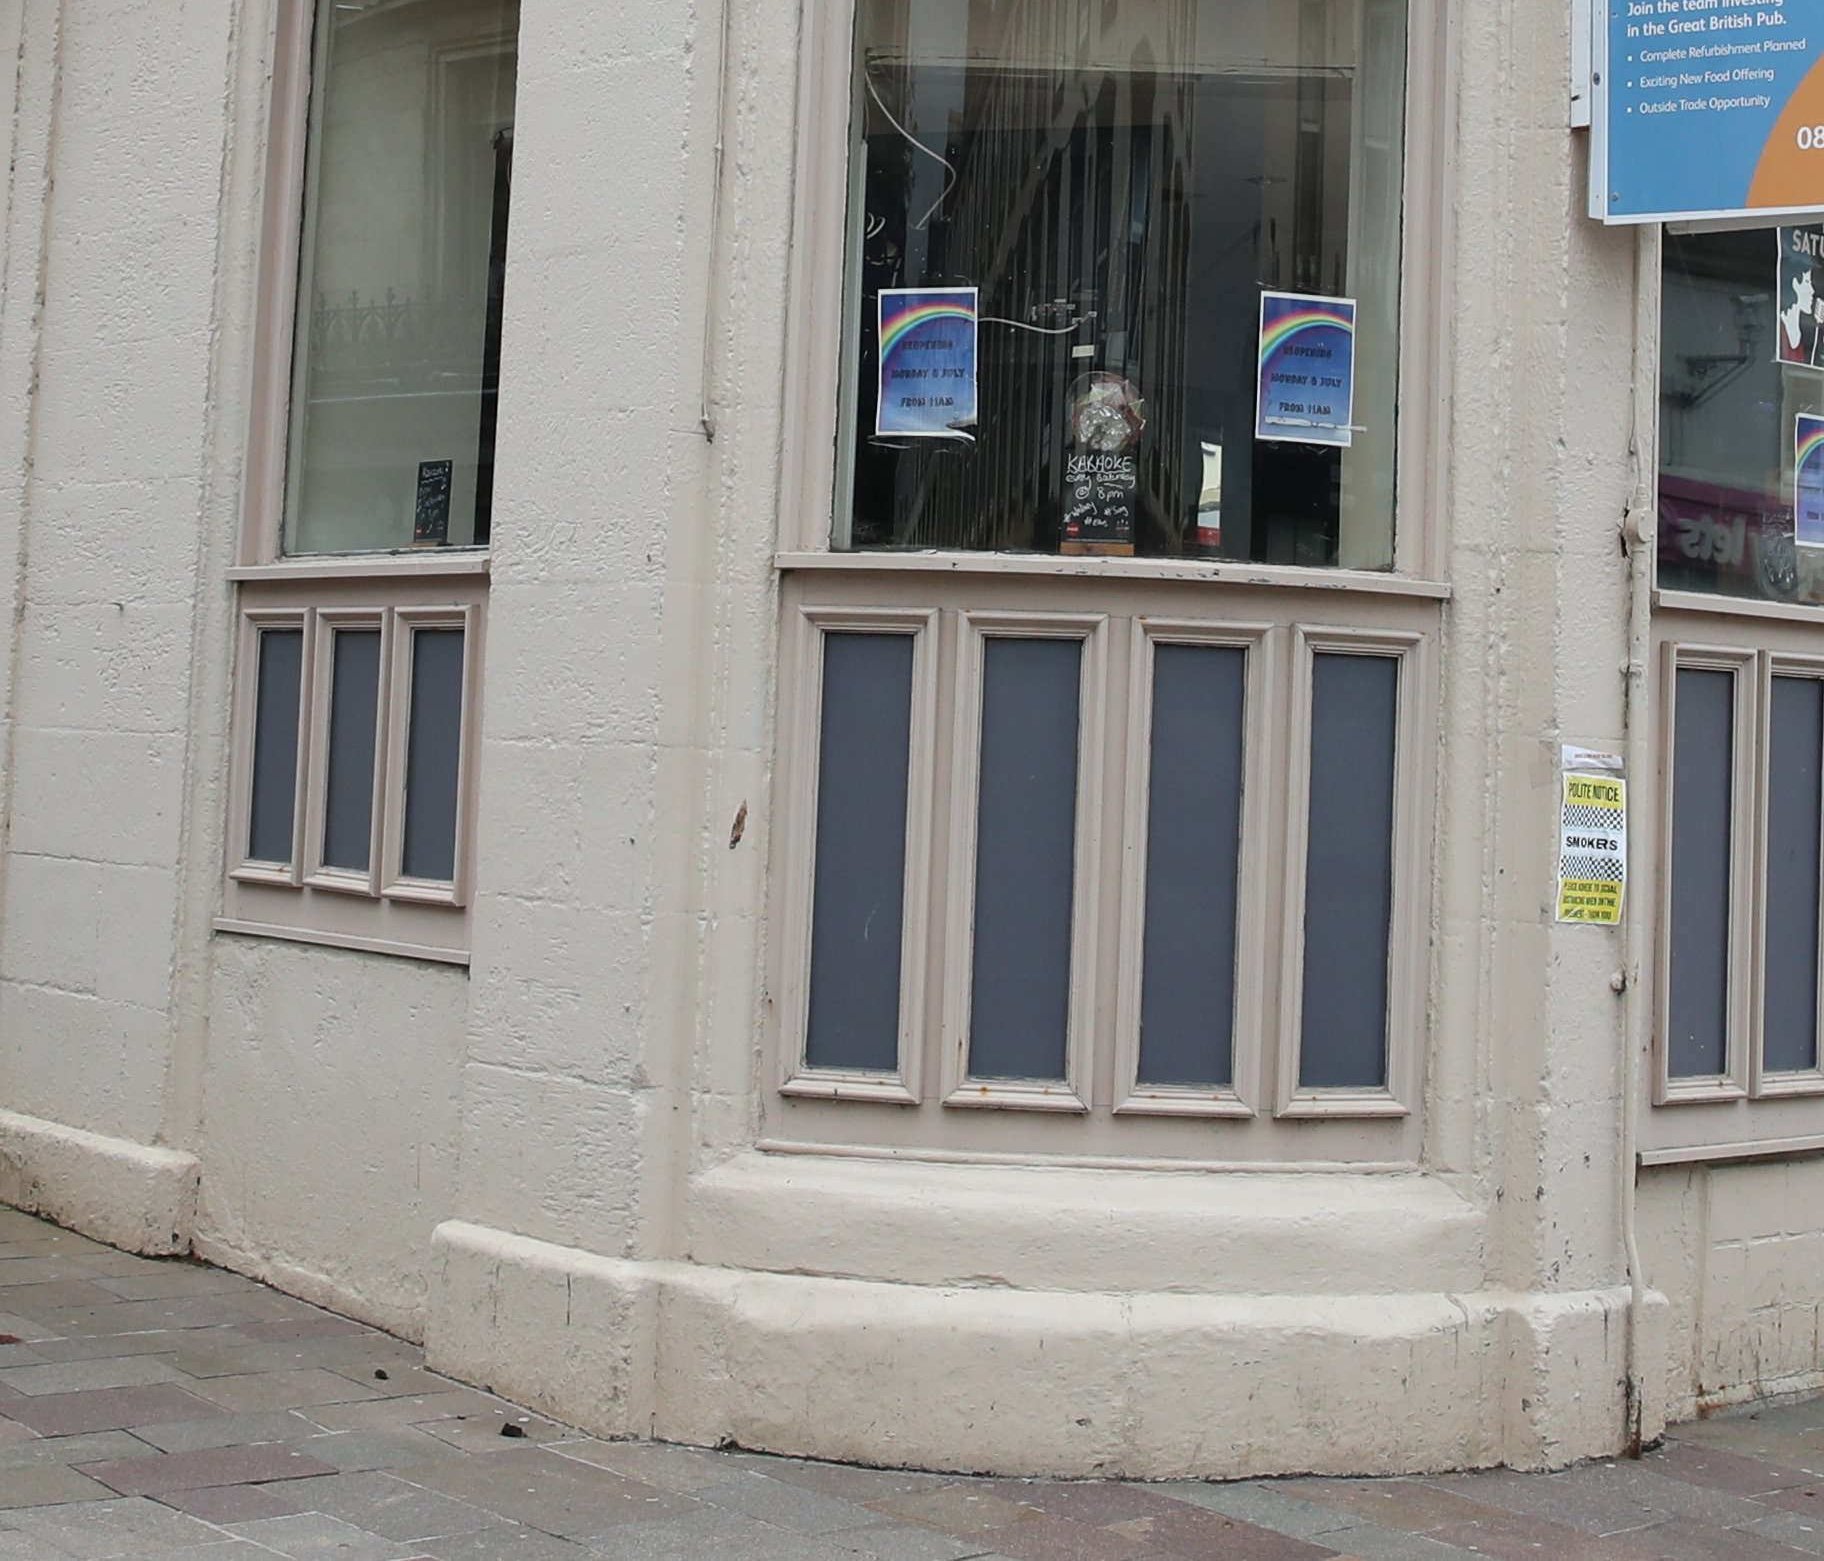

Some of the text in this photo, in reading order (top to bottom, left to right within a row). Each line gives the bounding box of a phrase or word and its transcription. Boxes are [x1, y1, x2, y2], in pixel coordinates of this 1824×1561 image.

[1627, 0, 1653, 17] Join
[1657, 0, 1679, 14] the
[1627, 11, 1786, 38] in the Great British Pub.
[1640, 38, 1806, 63] Complete Refurbishment Planned
[1640, 68, 1774, 89] Exciting New Food Offering
[1639, 95, 1771, 114] Outside Trade Opportunity
[891, 369, 928, 379] MONDAY
[941, 368, 965, 378] JULY
[1271, 373, 1308, 386] MONDAY
[1319, 377, 1342, 387] JULY
[900, 397, 954, 407] FROM 11AM
[1279, 402, 1331, 415] FROM 11AM
[1097, 486, 1124, 502] 8pm
[1568, 781, 1620, 802] POLITE NOTICE
[1565, 835, 1618, 851] SMOKERS
